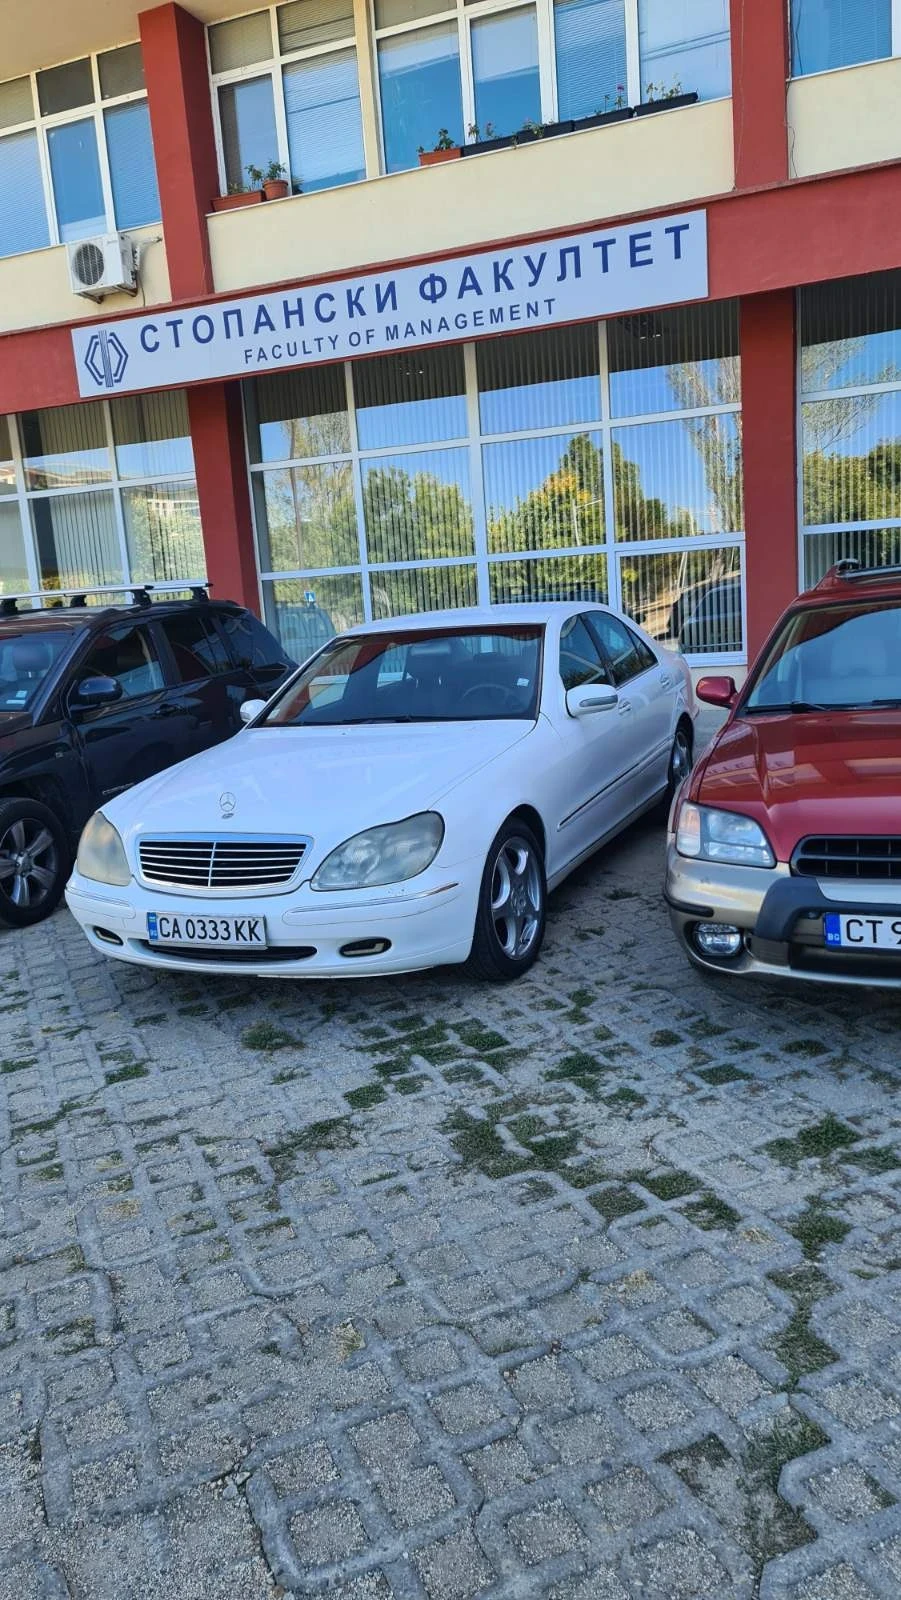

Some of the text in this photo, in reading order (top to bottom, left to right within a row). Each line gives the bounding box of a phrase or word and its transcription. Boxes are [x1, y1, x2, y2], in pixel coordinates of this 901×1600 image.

[139, 223, 690, 353] СТОПАНСКИ ФАКУЛТЕТ
[244, 298, 556, 364] FACULTY OF MANAGEMENT
